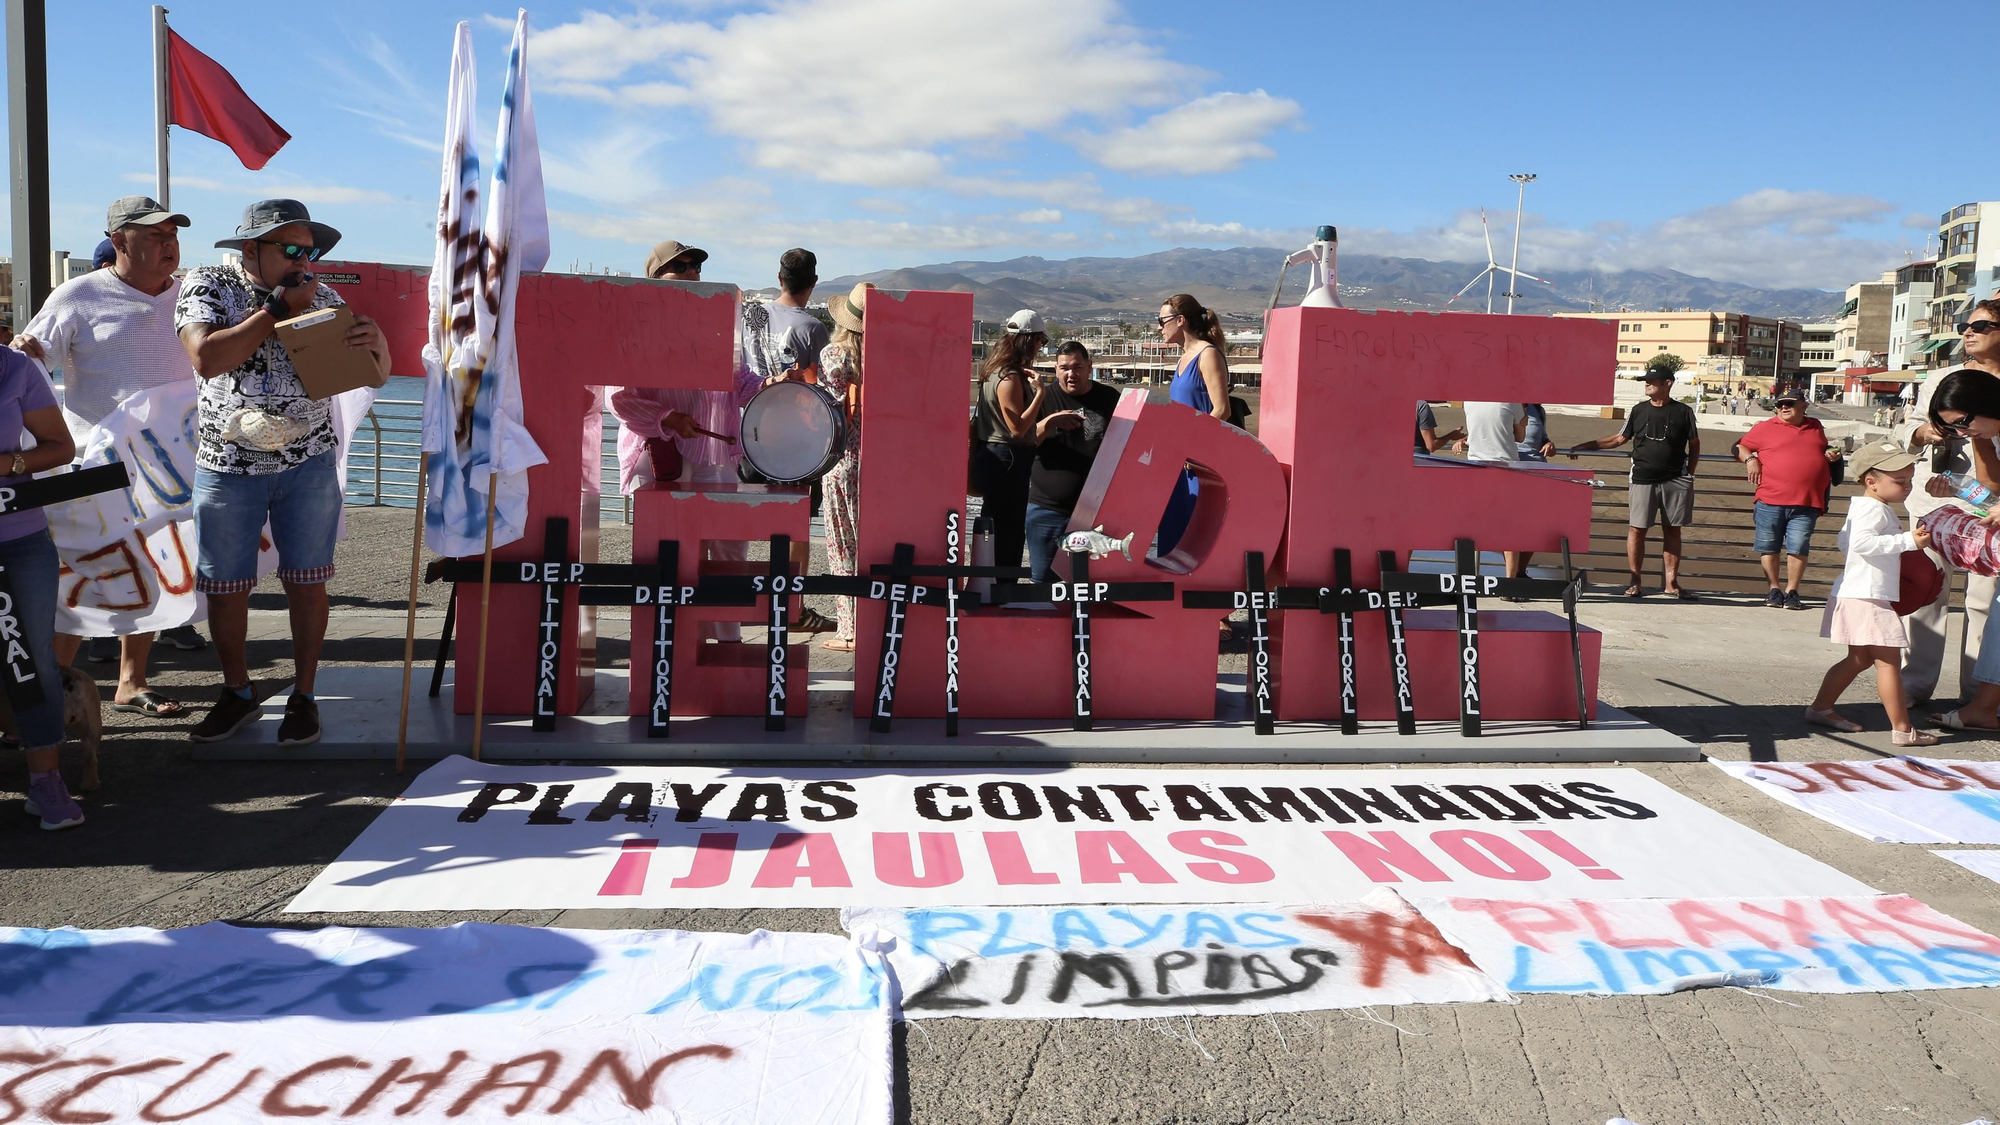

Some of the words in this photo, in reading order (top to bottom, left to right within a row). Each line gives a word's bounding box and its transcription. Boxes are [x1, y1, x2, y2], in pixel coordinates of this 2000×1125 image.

[946, 511, 960, 564] SOS
[520, 562, 585, 583] D.E.P.
[635, 585, 695, 605] D.E.P.
[870, 580, 927, 605] D.E.P.
[1051, 581, 1109, 602] D.E.P.
[1439, 573, 1499, 596] D.E.P.
[537, 584, 560, 716] LITORAL
[652, 605, 674, 728] LITORAL
[768, 594, 786, 716] LITORAL
[877, 600, 904, 717] LITORAL
[946, 578, 959, 713] LITORAL
[1074, 602, 1091, 717] LITORAL
[1252, 609, 1272, 714] LITORAL
[1338, 611, 1356, 714] LITORAL
[1389, 608, 1413, 712] LITORAL
[1460, 595, 1480, 716] LITORAL
[456, 779, 859, 826] PLAYAS
[913, 779, 1659, 825] CONTAMINADAS
[596, 828, 1276, 896] ¡JAULAS
[1321, 828, 1625, 883] NO!
[905, 909, 1302, 957] PLAYAS
[1447, 896, 2000, 955] PLAYAS
[1506, 939, 2000, 993] LIMPIAS
